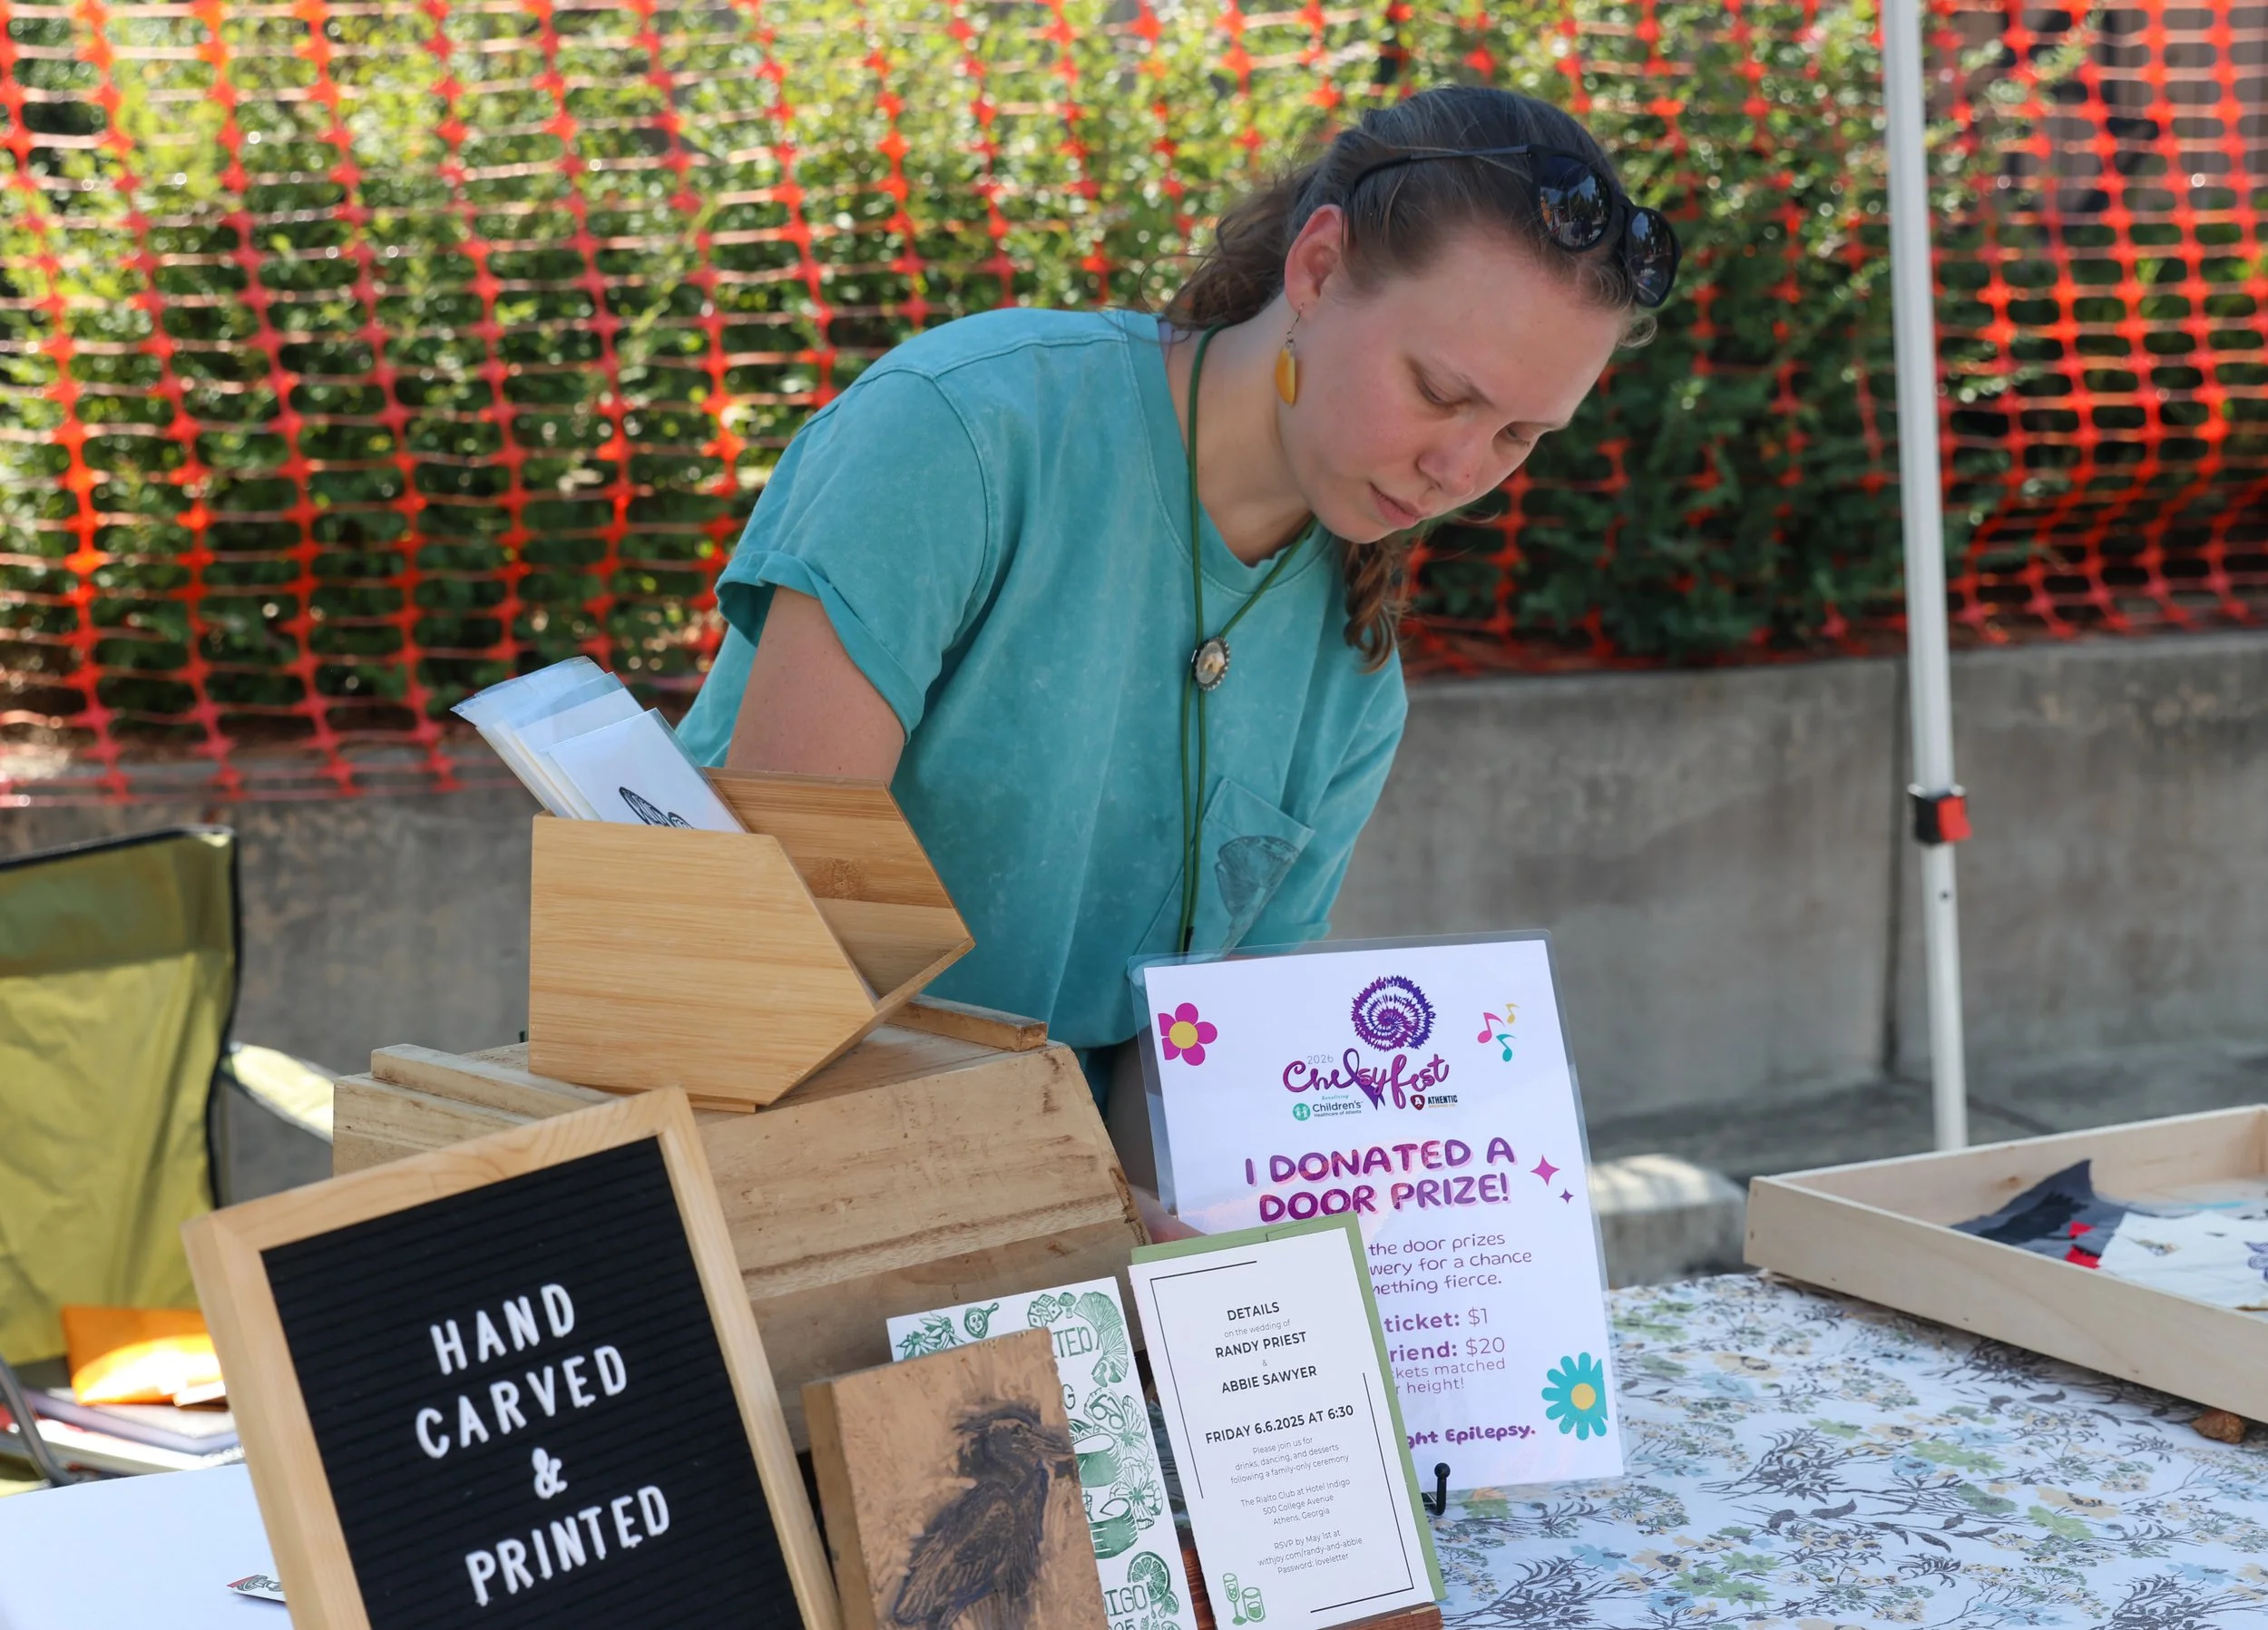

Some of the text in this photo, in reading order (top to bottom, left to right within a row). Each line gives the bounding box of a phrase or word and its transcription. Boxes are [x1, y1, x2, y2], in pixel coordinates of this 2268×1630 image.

[1306, 1055, 1334, 1065] 2026
[1312, 1099, 1362, 1113] Children's
[1428, 1095, 1458, 1105] ATHENTIC
[1246, 1137, 1516, 1186] I DONATED A
[1259, 1172, 1510, 1223] DOOR PRIZE!
[1368, 1233, 1506, 1256] the door prizes
[1370, 1250, 1532, 1276] wery for a chance
[1444, 1271, 1502, 1289] fierce.
[1227, 1301, 1280, 1322] DETAILS
[1384, 1307, 1488, 1332] ticket: $1
[430, 1284, 575, 1375] HAND
[1224, 1319, 1291, 1338] on the wedding of
[1215, 1331, 1306, 1359] RANDY PRIEST
[1390, 1337, 1505, 1362] riend: $20
[1262, 1359, 1267, 1367] &
[1392, 1358, 1506, 1379] kets matched
[1221, 1364, 1317, 1393] ABBIE SAWYER
[1407, 1377, 1464, 1394] height!
[415, 1345, 627, 1459] CARVED
[1205, 1404, 1354, 1444] FRIDAY 6.6.2025 AT 6:30
[1407, 1422, 1536, 1449] ght Epilepsy.
[1235, 1443, 1340, 1471] drinks, dancing, and desserts
[1252, 1436, 1314, 1455] Please join us for
[532, 1447, 568, 1499] &
[1230, 1471, 1264, 1485] following
[1271, 1461, 1311, 1477] family-only
[1313, 1454, 1349, 1469] ceremony
[1240, 1479, 1351, 1508] The Rialto Club at Hotel Indigo
[1263, 1494, 1334, 1516] 500 College Avenue
[1273, 1507, 1330, 1526] Athens, Georgia
[464, 1485, 670, 1606] PRINTED
[1257, 1537, 1363, 1567] withjoy.com/randy-and-abbie
[1274, 1529, 1341, 1550] RSVP by May 1st at
[1276, 1552, 1350, 1575] Password: loveletter
